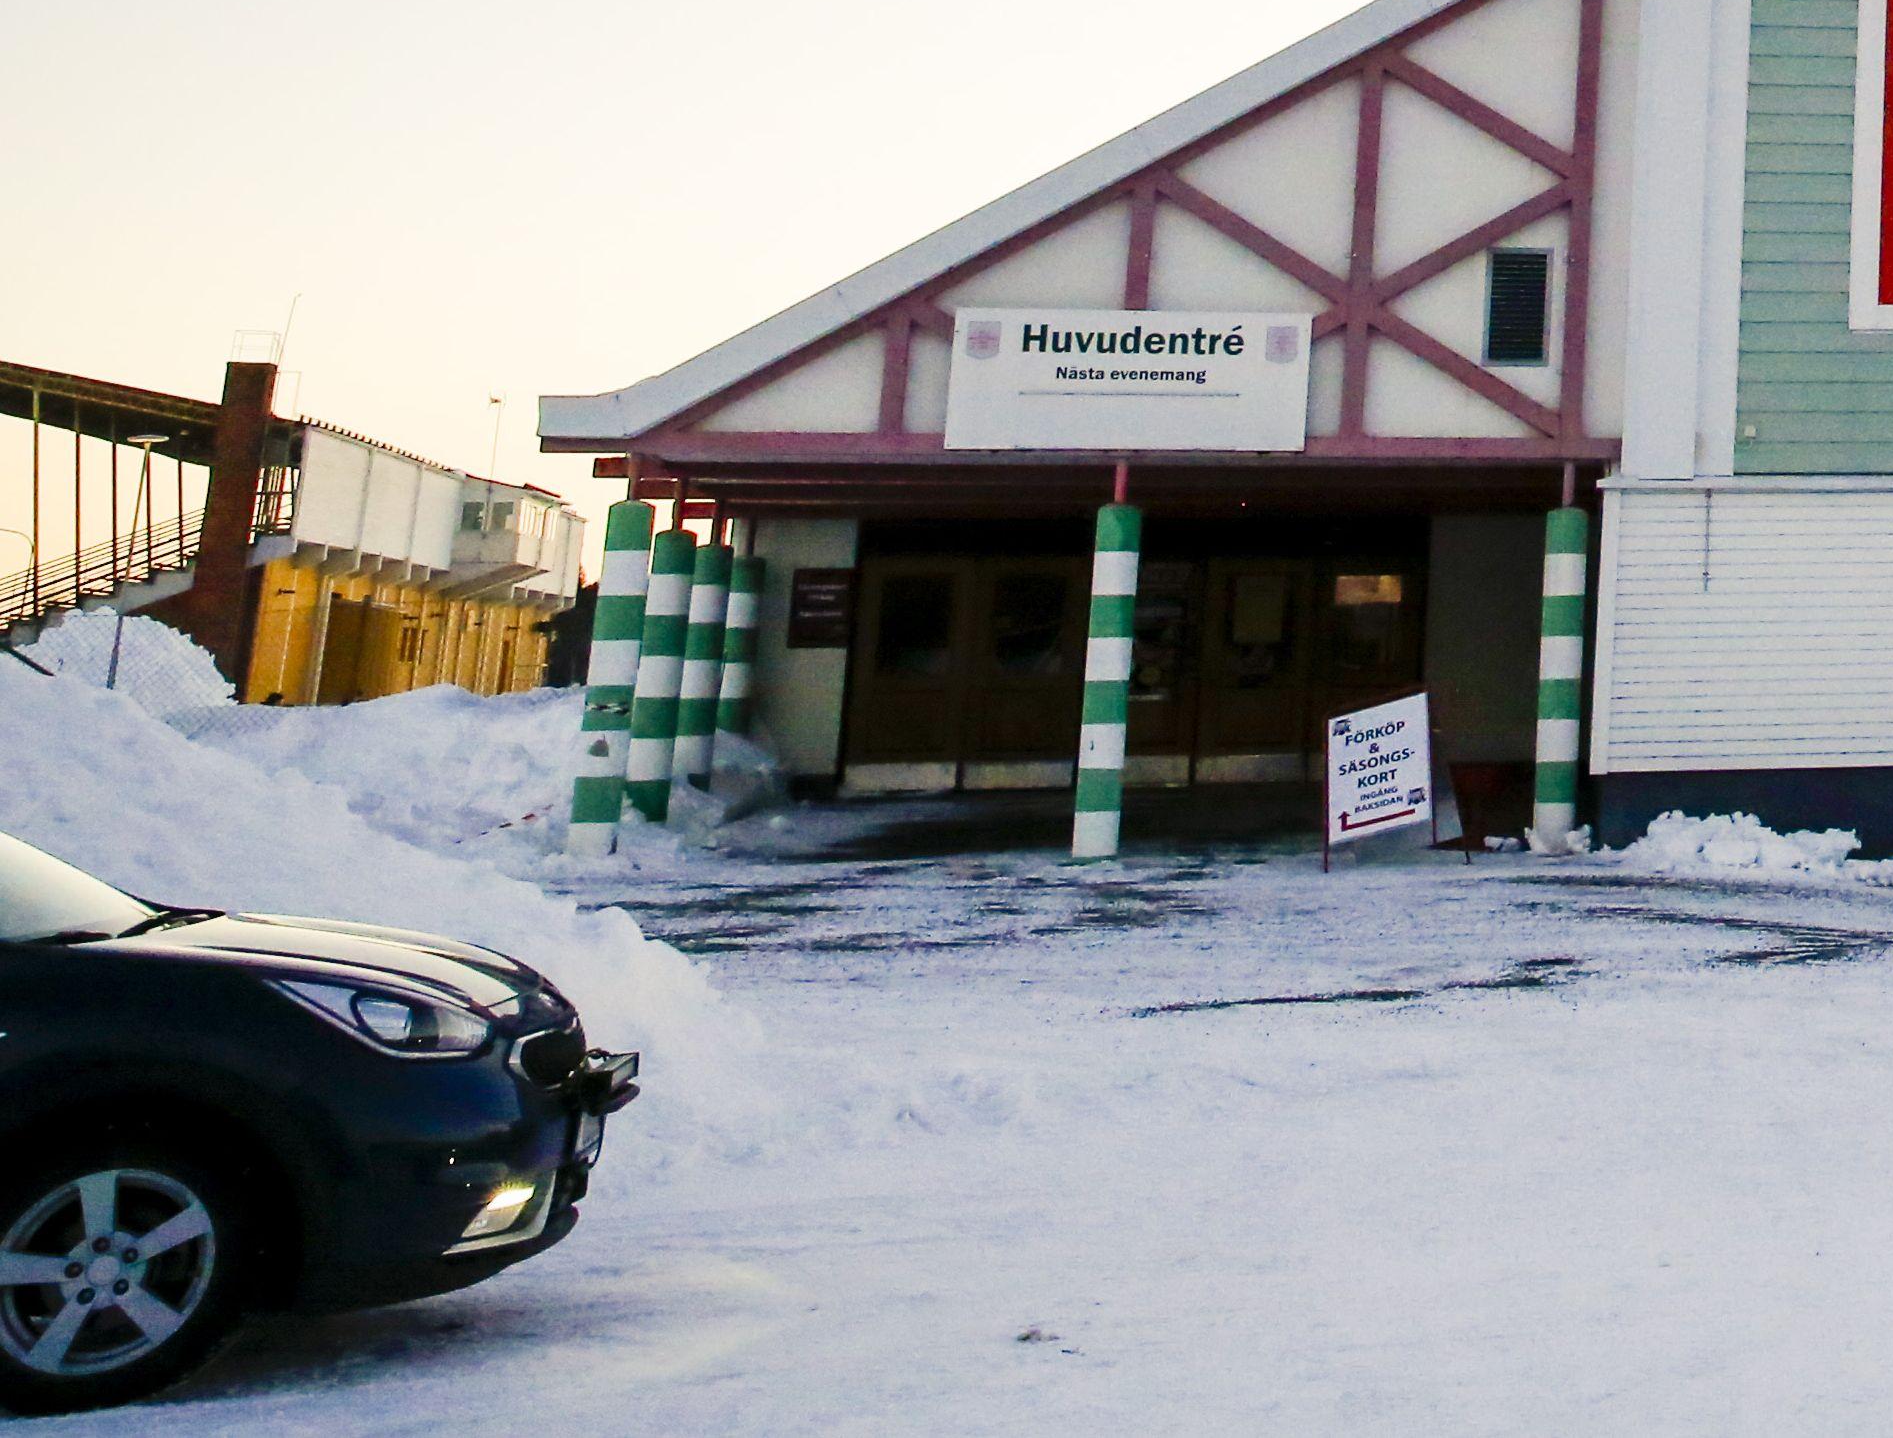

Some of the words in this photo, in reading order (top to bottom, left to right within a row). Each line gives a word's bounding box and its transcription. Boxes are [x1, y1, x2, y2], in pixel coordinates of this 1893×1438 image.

[1022, 323, 1245, 356] Huvudentré
[1056, 366, 1105, 381] Nästa
[1110, 368, 1206, 384] evenemang
[1345, 720, 1405, 746] FÖRKÖP
[1369, 742, 1379, 754] &
[1338, 747, 1415, 776] SÄSONGS-
[1357, 769, 1398, 788] KORT
[1360, 786, 1398, 801] INGÅNG
[1354, 795, 1404, 813] BAKSIDAN
